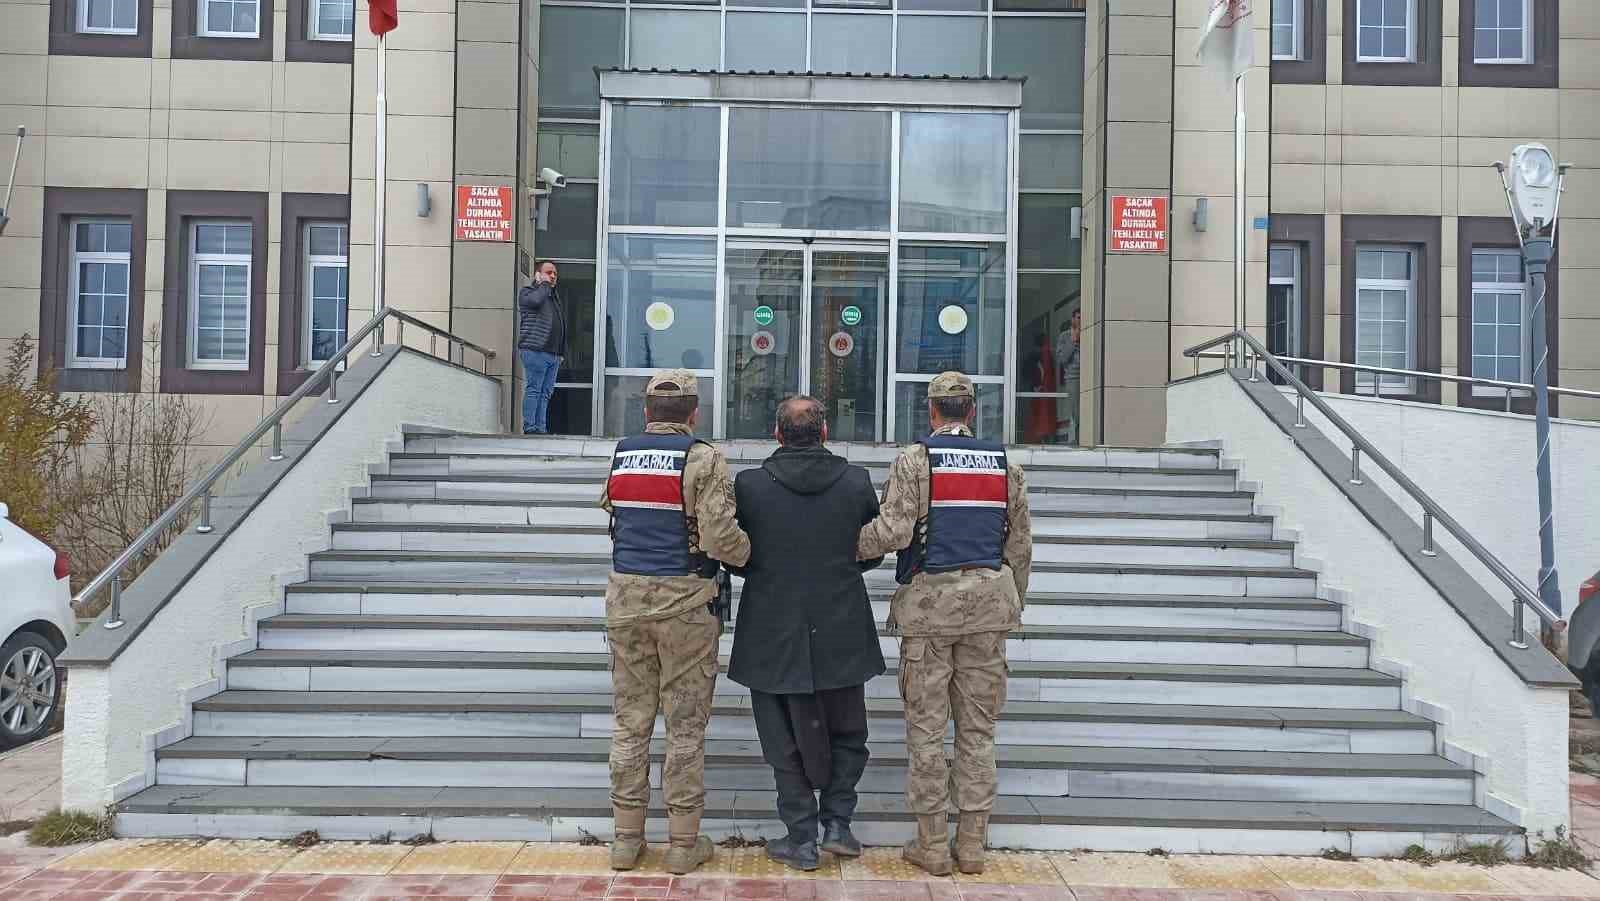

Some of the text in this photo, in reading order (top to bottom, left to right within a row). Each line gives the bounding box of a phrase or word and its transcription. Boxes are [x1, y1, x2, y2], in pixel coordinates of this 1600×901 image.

[466, 198, 502, 207] ALTINDA
[466, 208, 503, 218] DURMAK
[1122, 208, 1157, 218] ALTINDA
[500, 220, 511, 229] VE
[1121, 219, 1157, 229] DURMAK
[1154, 231, 1166, 240] VE
[620, 454, 675, 470] JANDARMA
[939, 453, 1000, 470] JANDARMA
